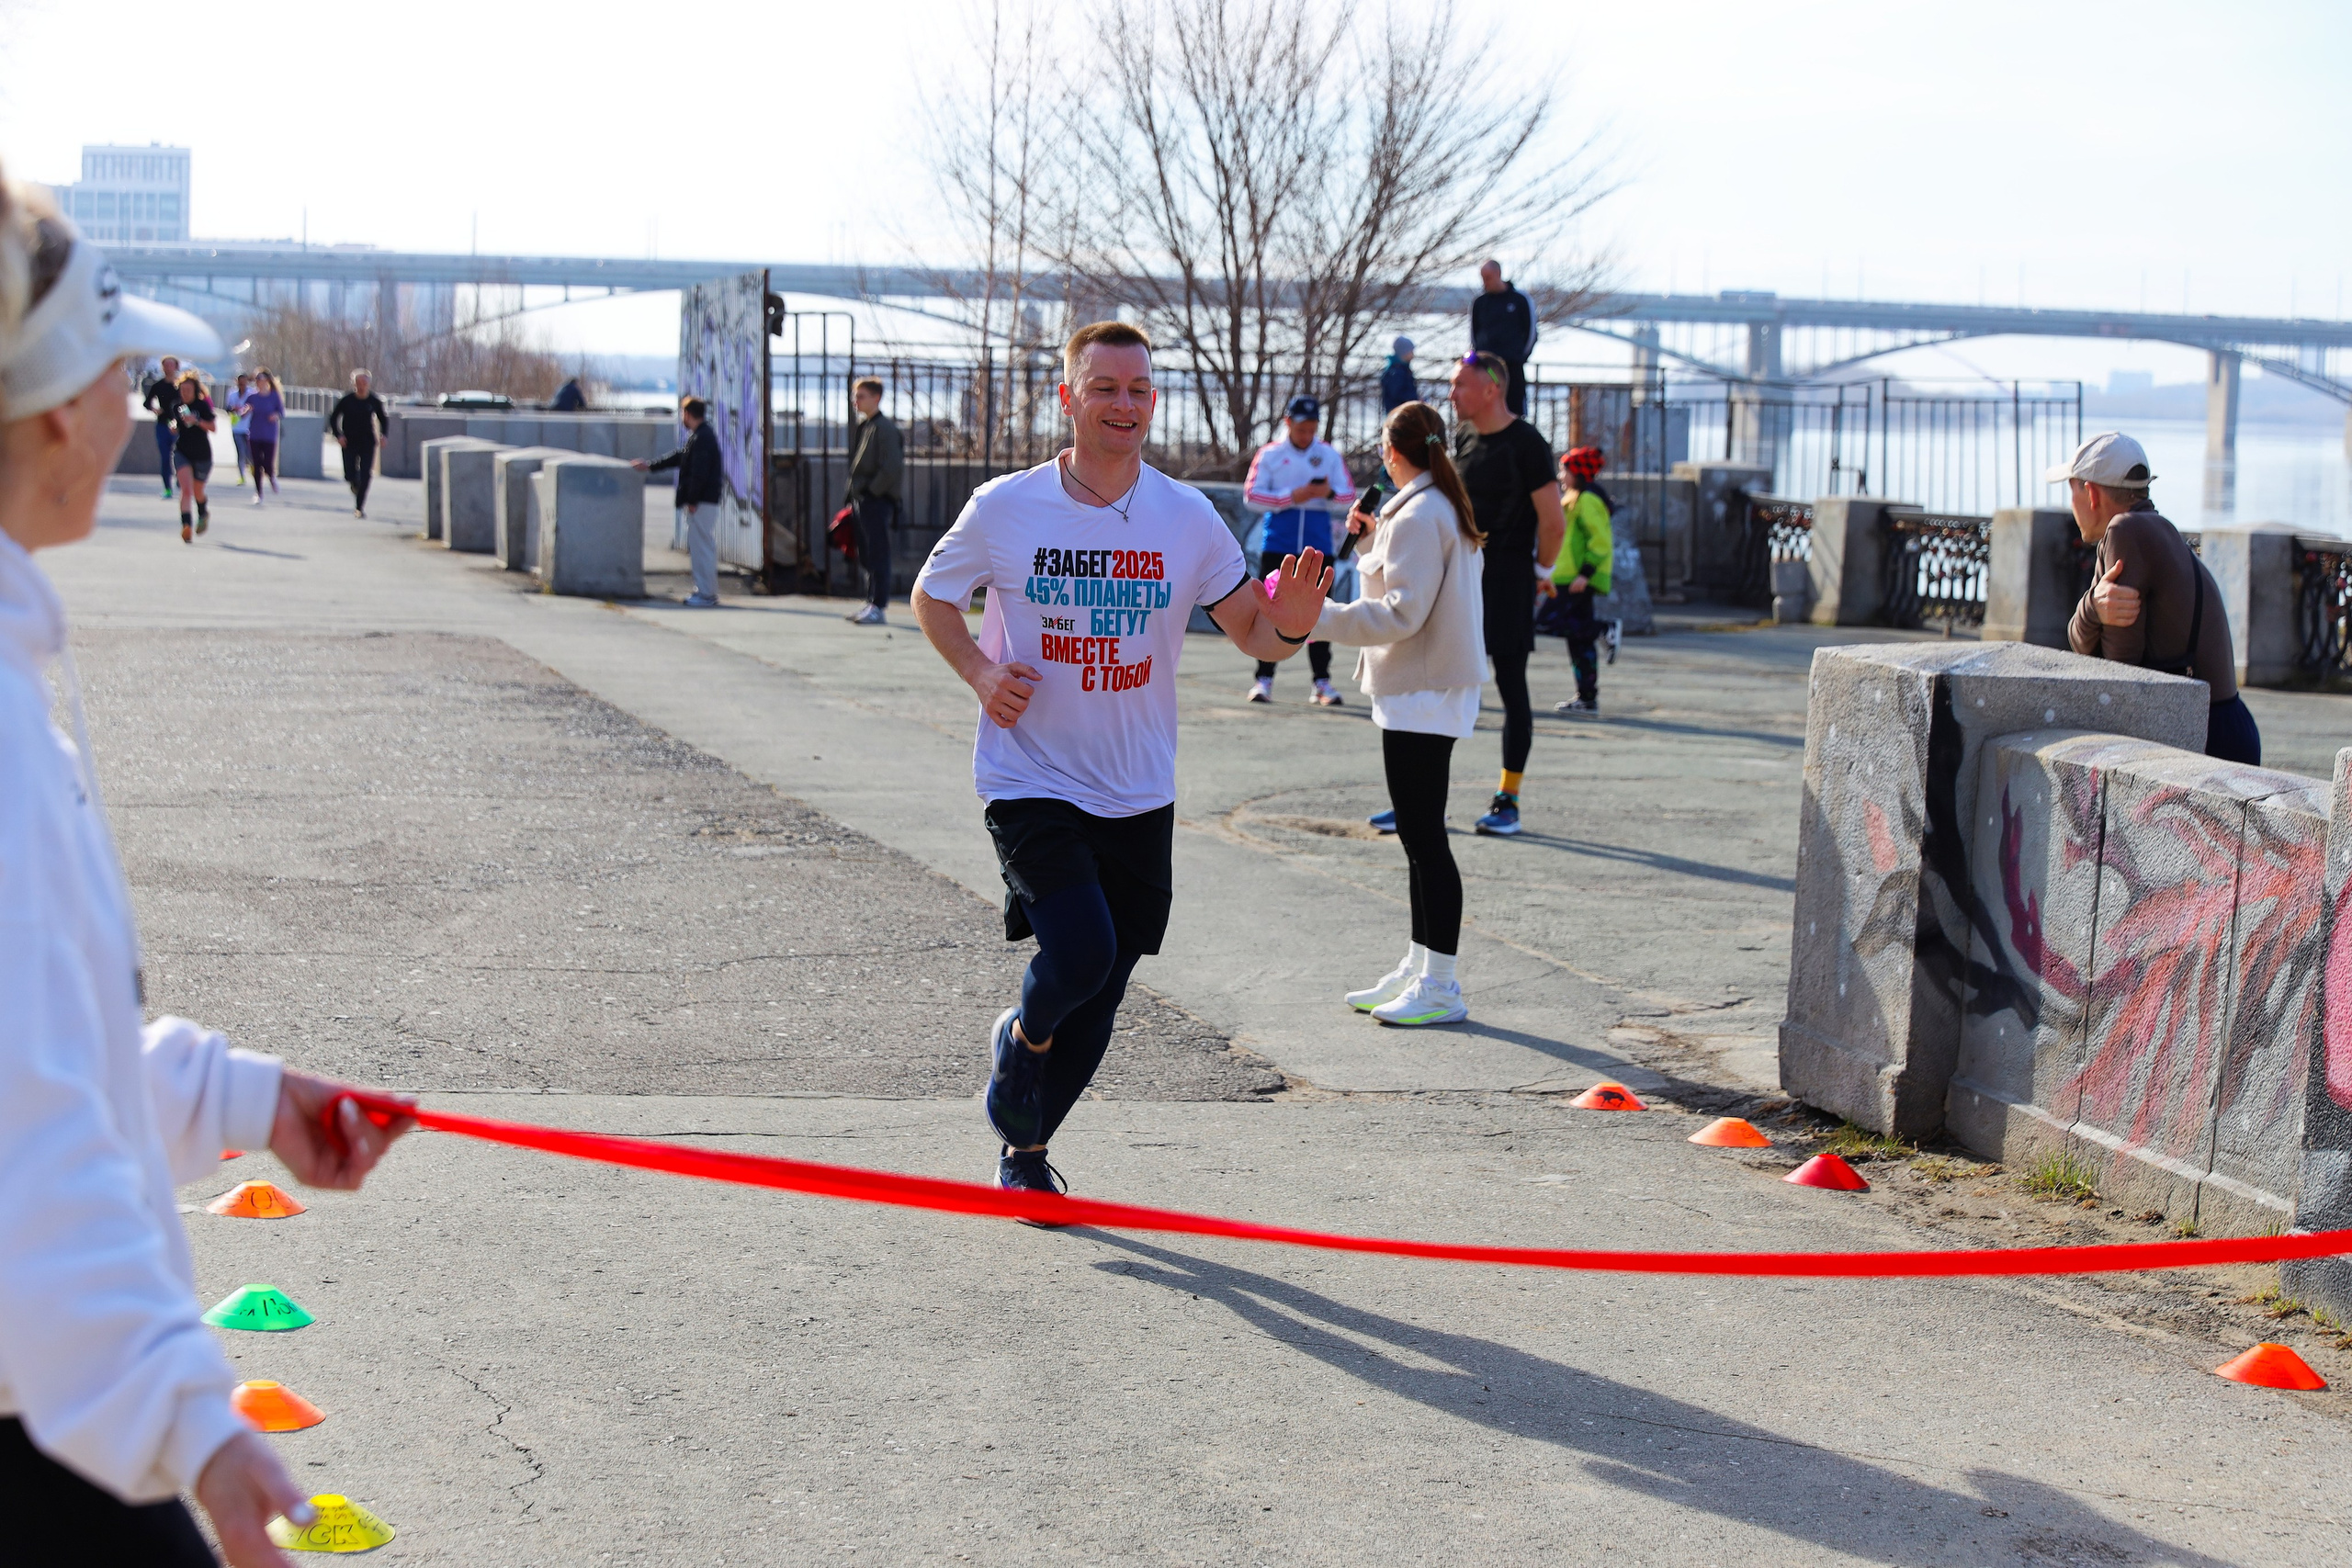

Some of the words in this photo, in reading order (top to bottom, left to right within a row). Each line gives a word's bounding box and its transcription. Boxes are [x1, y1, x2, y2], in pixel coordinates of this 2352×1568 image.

[1033, 547, 1165, 581] #ЗАБЕГ2025
[1024, 576, 1069, 606] 45%
[1074, 580, 1171, 609] ПЛАНЕТЫ
[1091, 609, 1151, 637] БЕГУТ
[1041, 633, 1120, 665] ВМЕСТЕ
[1081, 666, 1096, 692] С
[1101, 654, 1153, 693] ТОБОЙ
